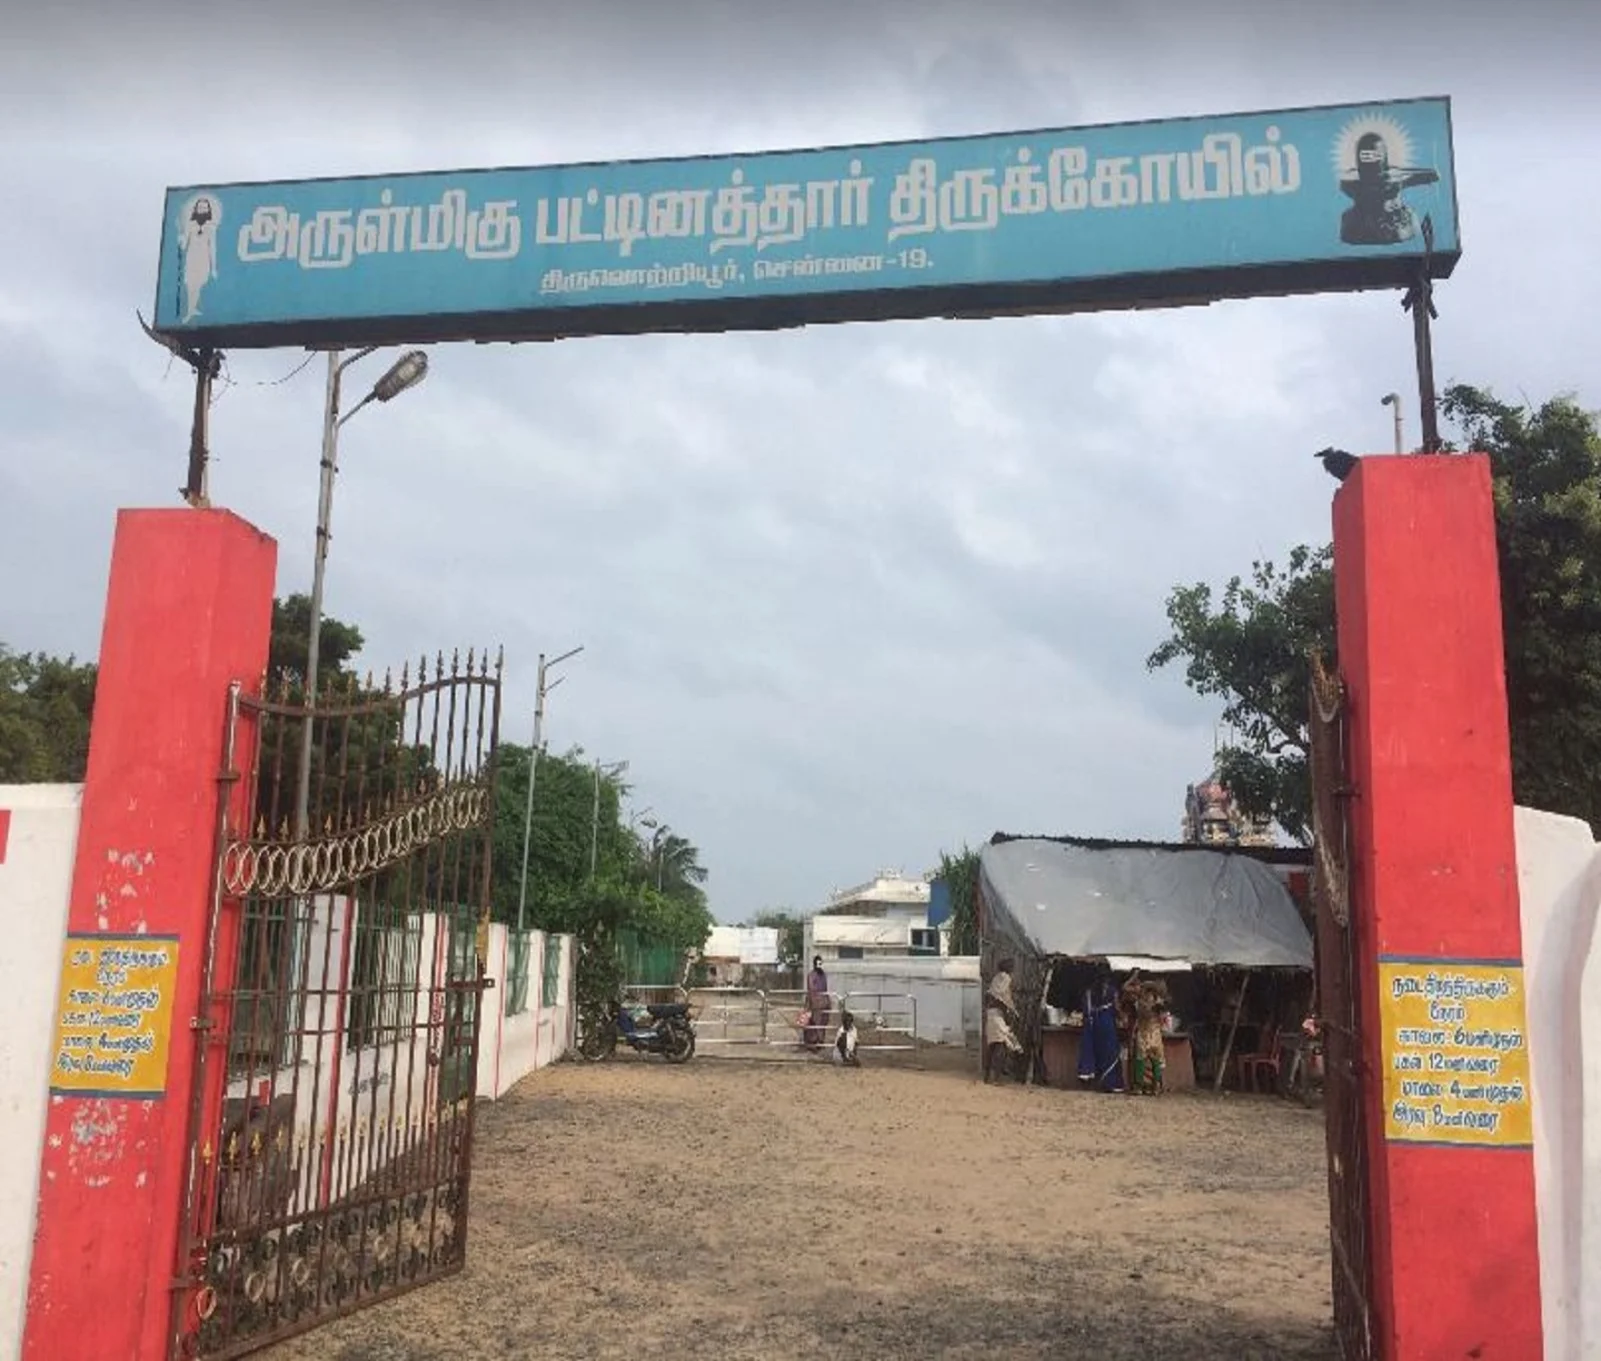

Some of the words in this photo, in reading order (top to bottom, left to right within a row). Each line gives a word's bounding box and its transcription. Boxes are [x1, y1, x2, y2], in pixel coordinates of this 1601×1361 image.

[237, 188, 521, 269] அருள்மிகு
[534, 159, 875, 257] பட்டினத்தார்
[888, 125, 1301, 243] திருக்கோயில்
